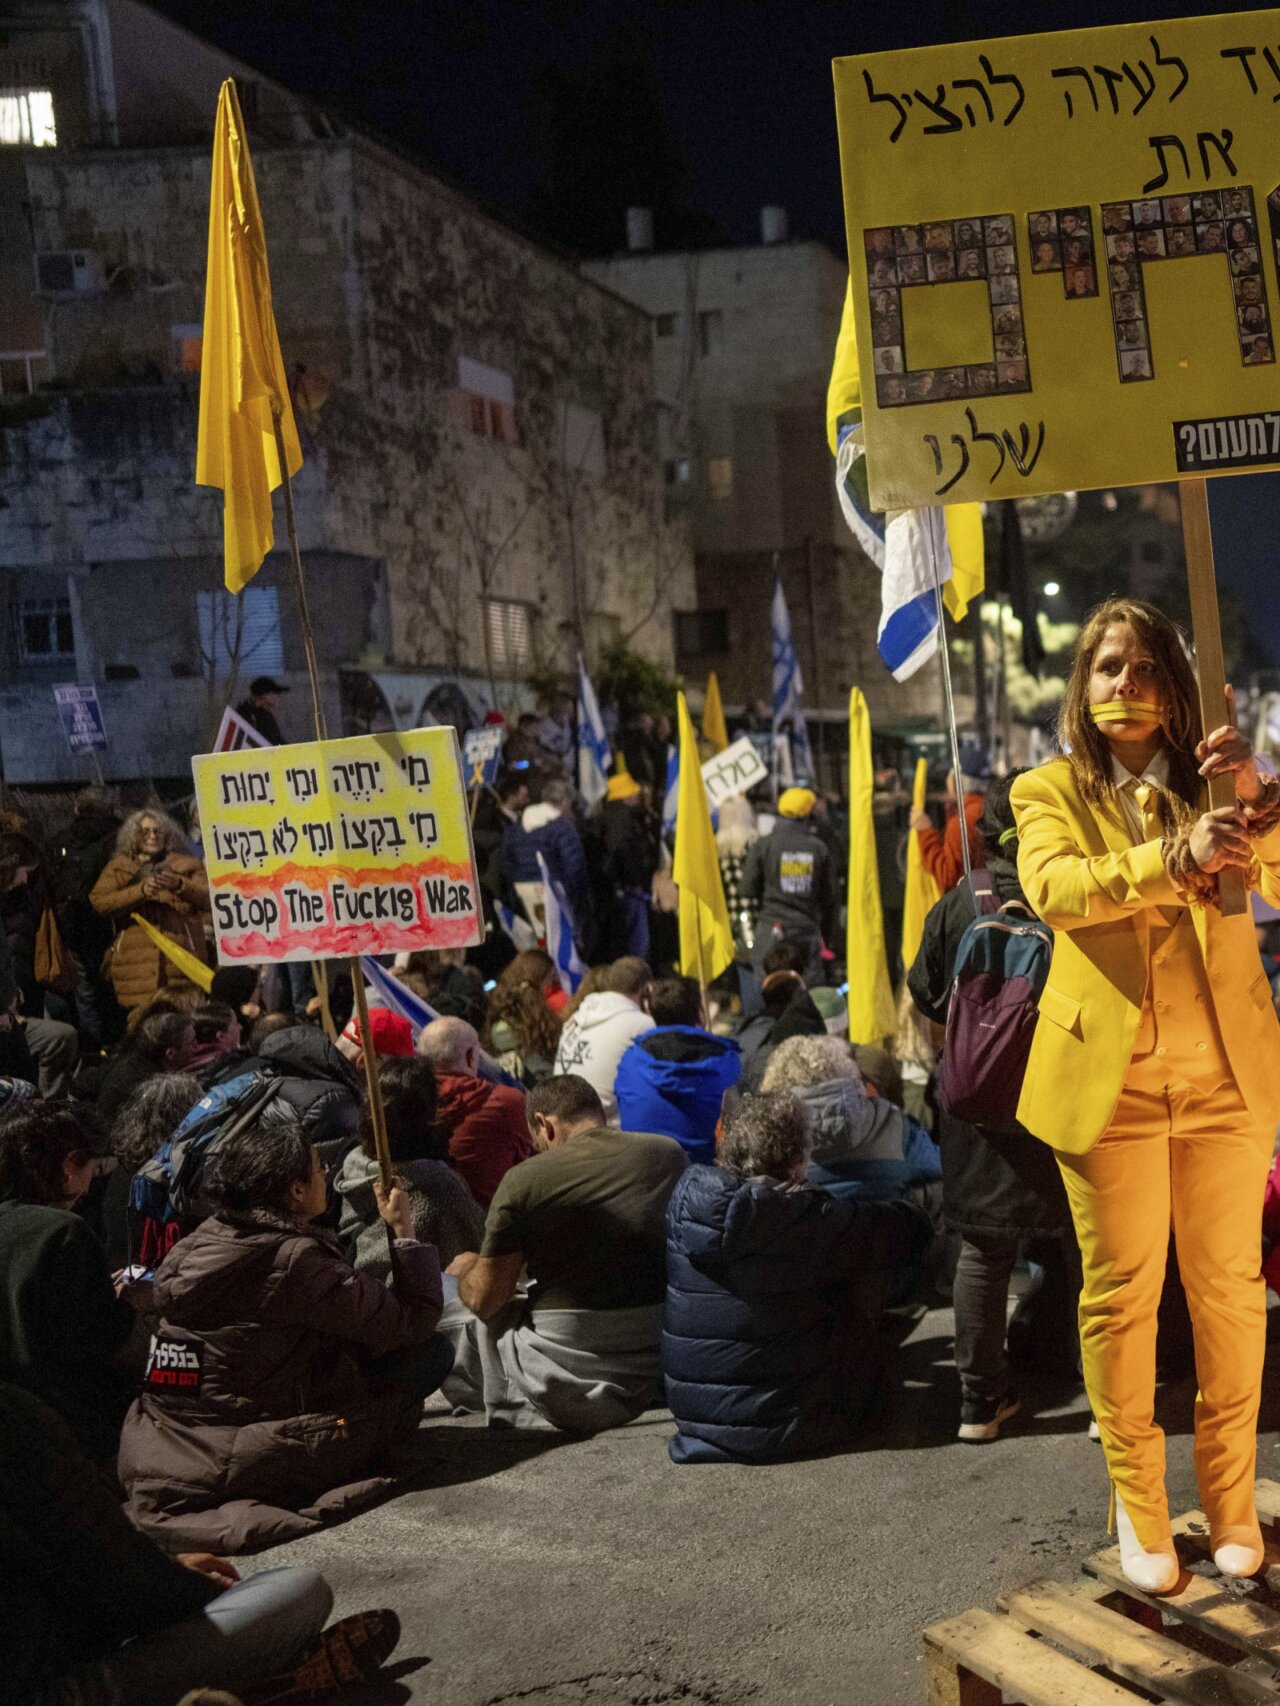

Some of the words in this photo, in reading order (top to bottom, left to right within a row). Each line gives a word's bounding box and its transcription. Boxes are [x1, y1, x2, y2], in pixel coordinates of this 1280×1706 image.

[862, 55, 1025, 143] להציל
[1052, 36, 1189, 119] לעזה
[1143, 129, 1238, 195] את
[922, 406, 1046, 496] שלנו
[1179, 414, 1280, 463] למענם?
[214, 893, 278, 933] Stop
[284, 888, 324, 923] The
